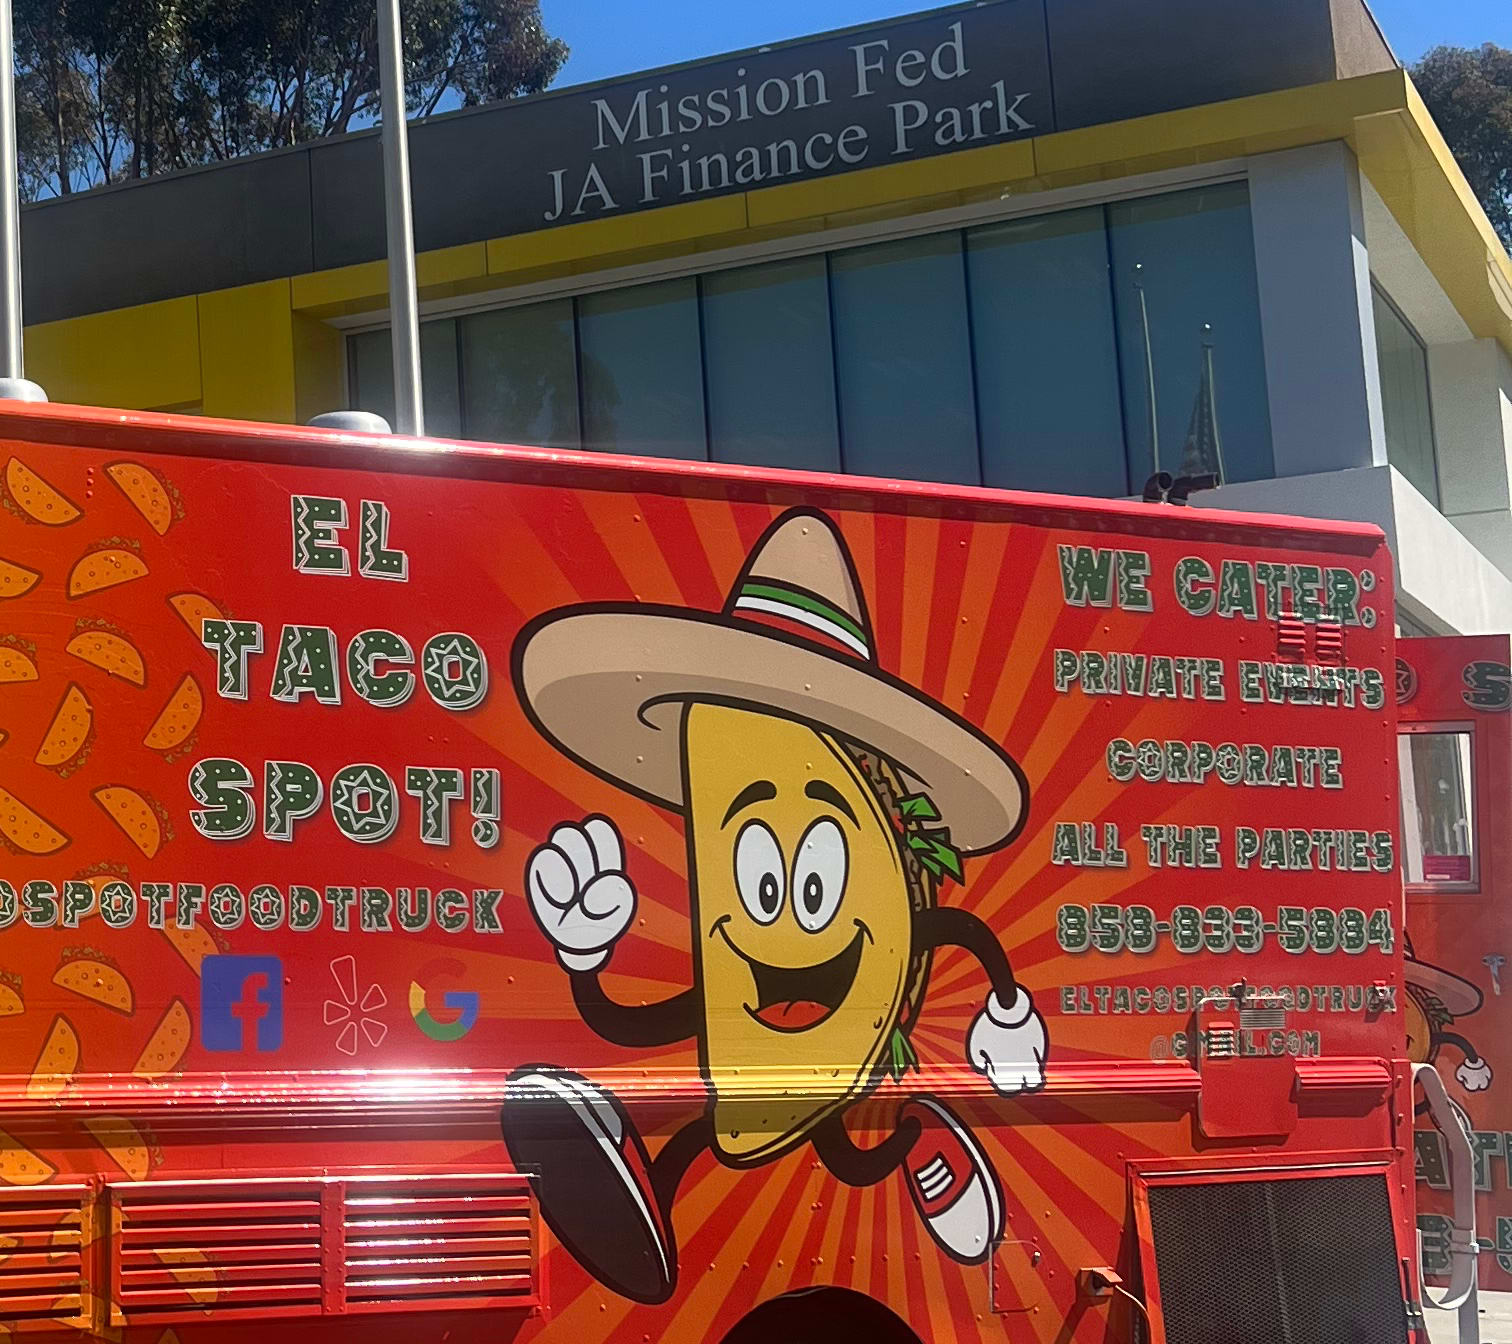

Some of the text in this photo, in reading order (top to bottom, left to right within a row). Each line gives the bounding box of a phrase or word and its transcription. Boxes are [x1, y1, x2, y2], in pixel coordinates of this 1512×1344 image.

[590, 22, 970, 150] Mission Fed
[542, 80, 1035, 222] JA Finance Park
[290, 494, 409, 582] EL
[1056, 544, 1377, 630] WE CATER:
[201, 618, 489, 711] TACO
[1054, 649, 1226, 702] PRIVATE
[1239, 659, 1386, 710] EVENTS
[188, 757, 501, 849] SPOT!
[1106, 738, 1344, 789] CORPORATE
[1051, 822, 1128, 869] ALL
[1140, 824, 1223, 870] THE
[1235, 826, 1395, 873] PARTIES
[1056, 903, 1395, 955] 858-833-5884
[1150, 1028, 1321, 1064] @GMIL.COM
